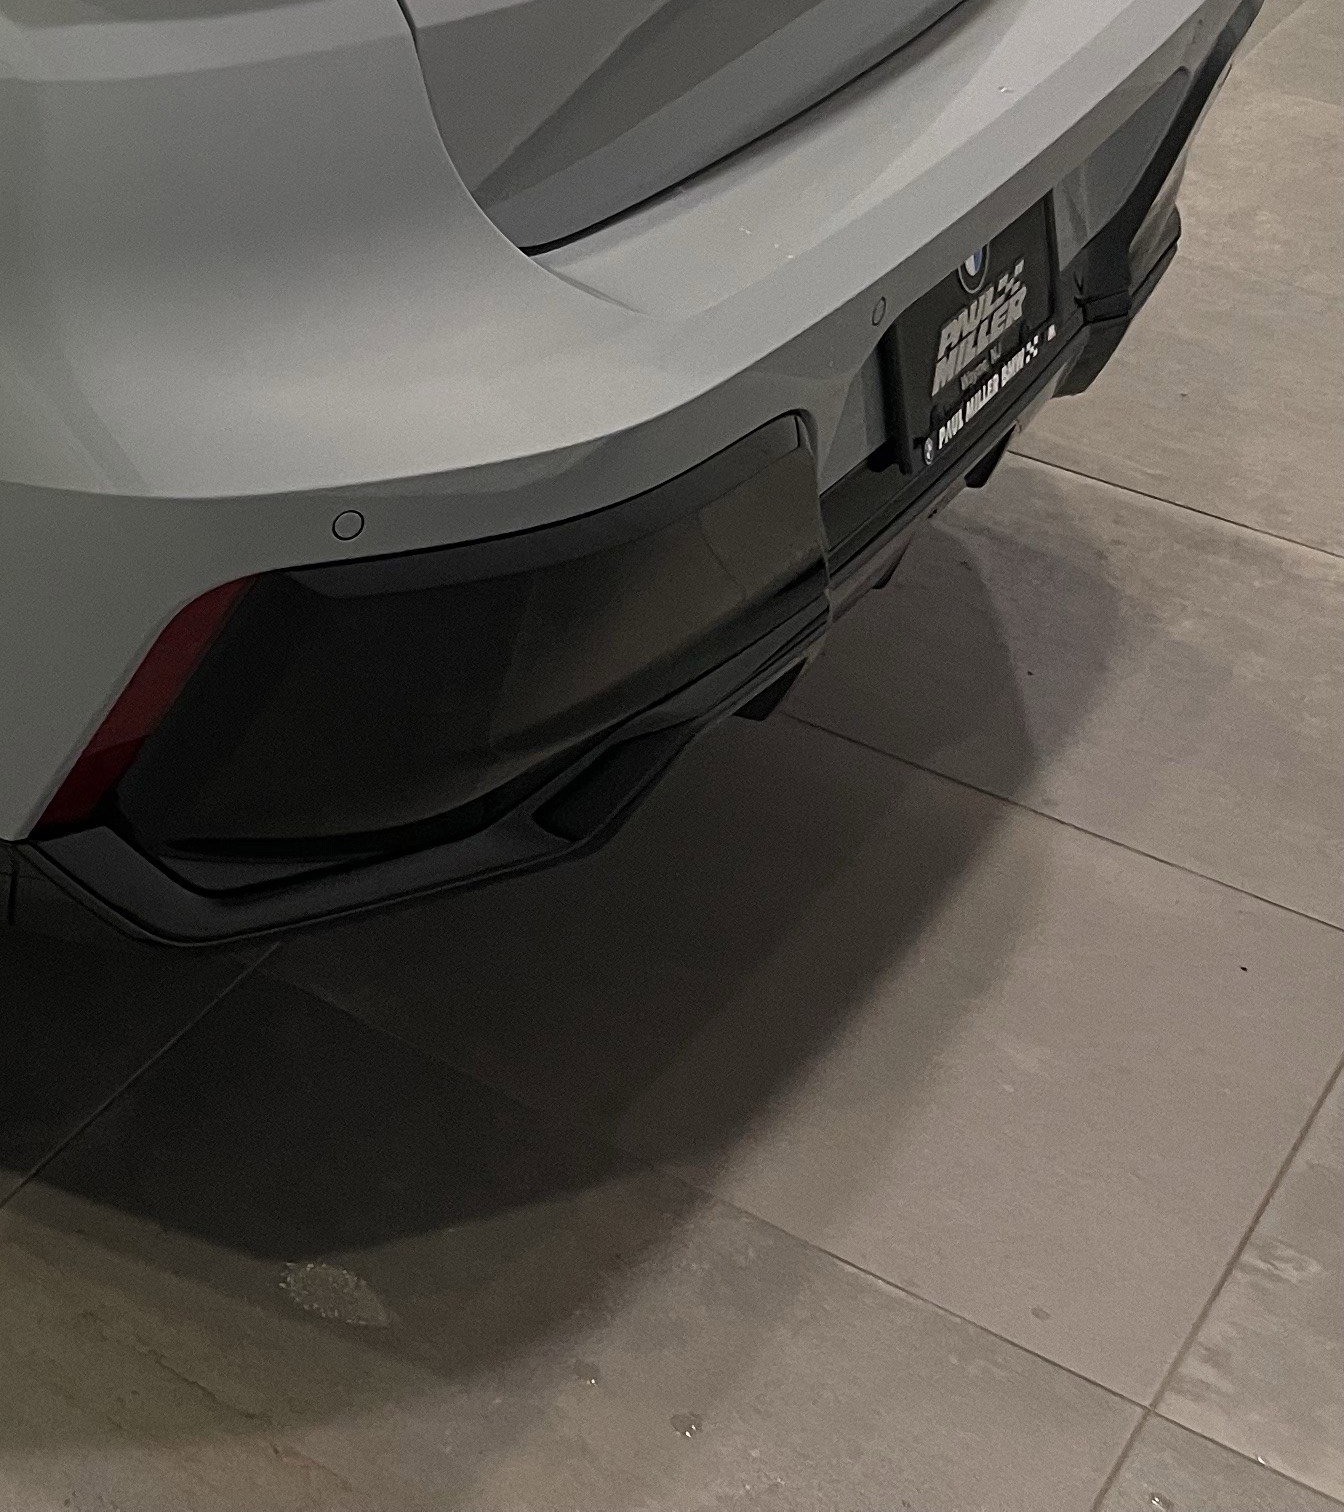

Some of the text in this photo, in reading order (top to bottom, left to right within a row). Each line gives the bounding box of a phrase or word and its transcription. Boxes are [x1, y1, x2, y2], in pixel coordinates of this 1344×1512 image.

[932, 286, 1027, 397] MILLER
[936, 286, 1007, 358] PAUL
[938, 409, 964, 449] PAUL
[965, 374, 999, 423] MILLER
